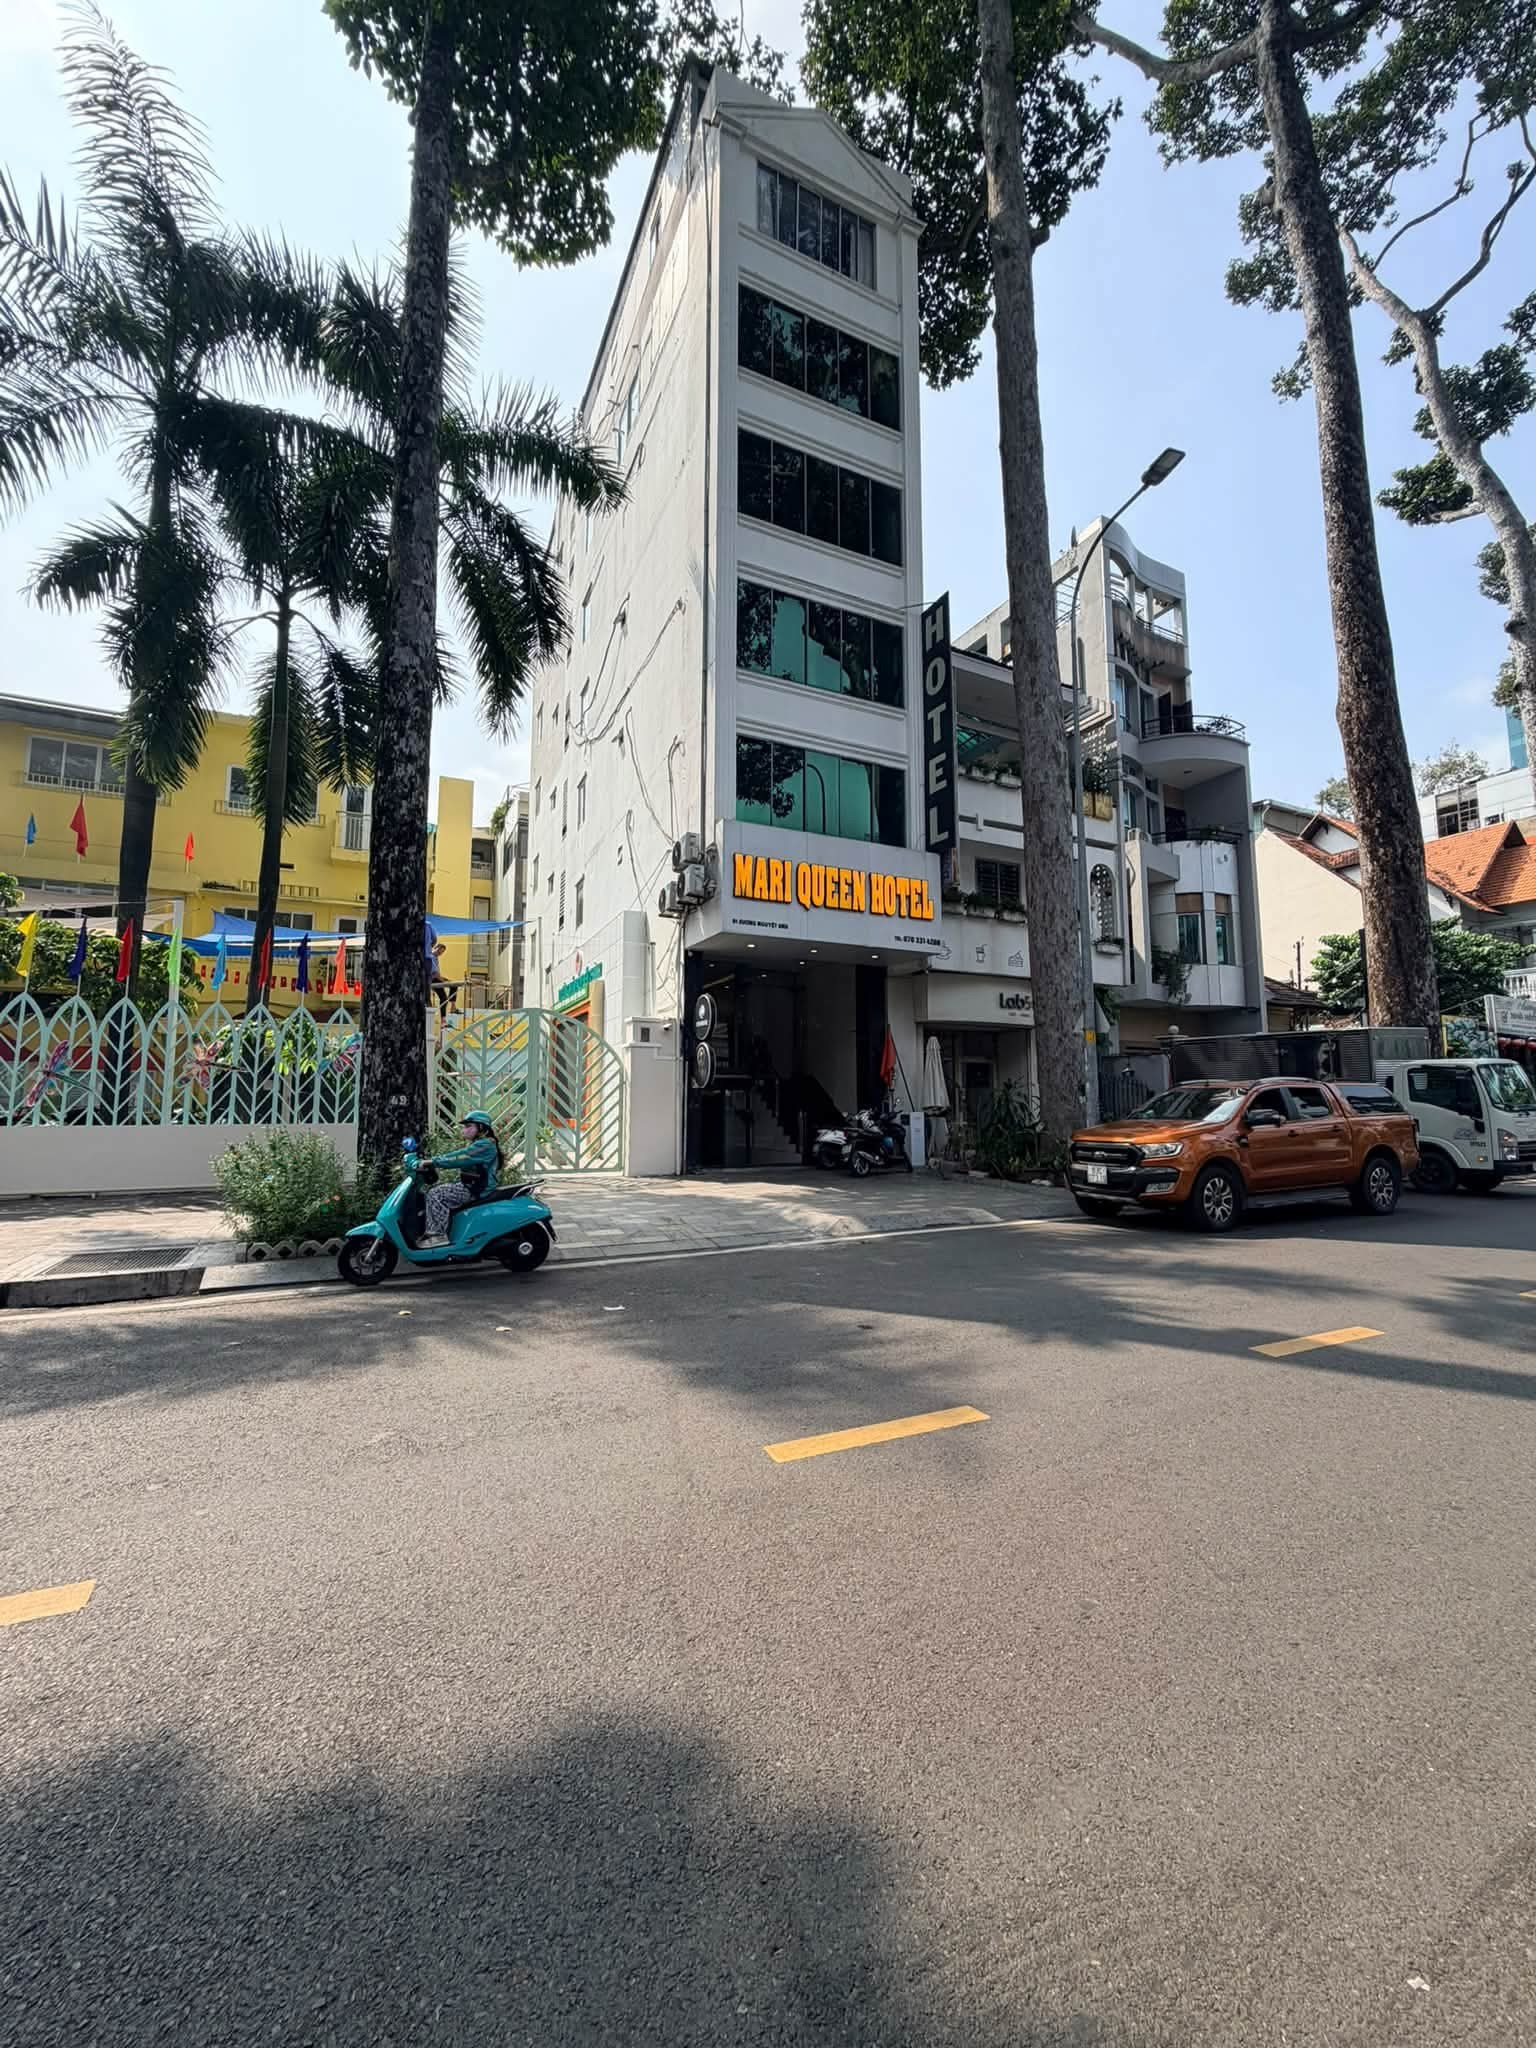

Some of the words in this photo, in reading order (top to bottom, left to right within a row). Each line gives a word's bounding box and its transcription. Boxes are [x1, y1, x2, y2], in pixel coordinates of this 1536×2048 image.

[925, 604, 949, 846] HOTEL
[733, 852, 792, 904] MARI
[797, 861, 866, 912] QUEEN
[868, 871, 935, 921] HOTEL
